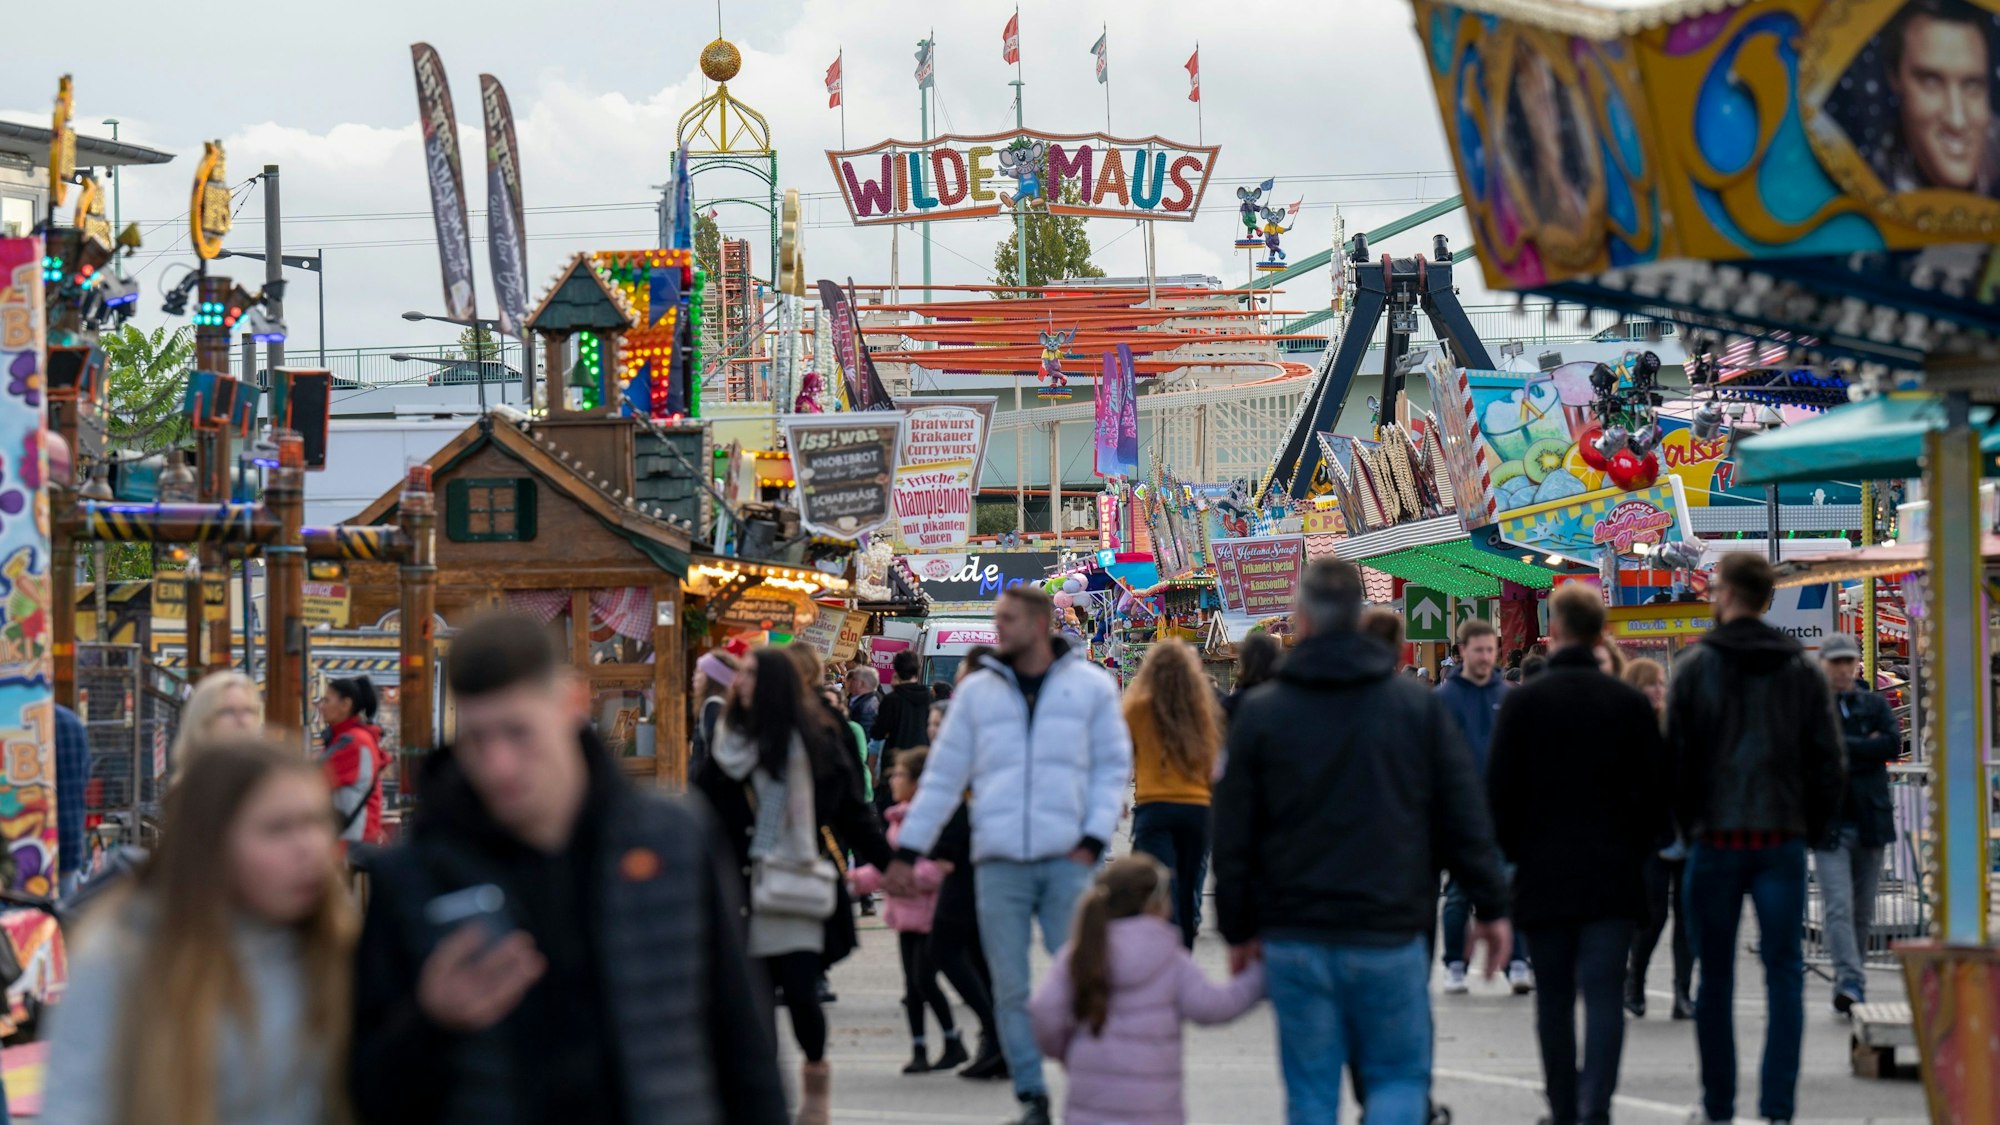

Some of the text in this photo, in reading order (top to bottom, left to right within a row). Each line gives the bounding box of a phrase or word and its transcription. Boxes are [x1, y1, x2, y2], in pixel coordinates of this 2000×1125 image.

[841, 143, 1203, 217] WILDE MAUS
[911, 418, 975, 430] Bratwurst
[911, 431, 973, 443] Krakauer
[907, 443, 977, 457] Currywurst
[906, 472, 955, 488] Frische
[893, 485, 970, 520] Champignons
[903, 520, 965, 535] mit pikanten
[1099, 495, 1109, 549] PUSHER
[919, 533, 952, 546] Saucen
[1236, 545, 1271, 560] Holland
[1270, 542, 1298, 558] Snack
[1242, 561, 1272, 575] Frikandel
[1272, 560, 1295, 574] Spezial
[159, 583, 225, 601] EINNG
[1627, 619, 1667, 631] Musik
